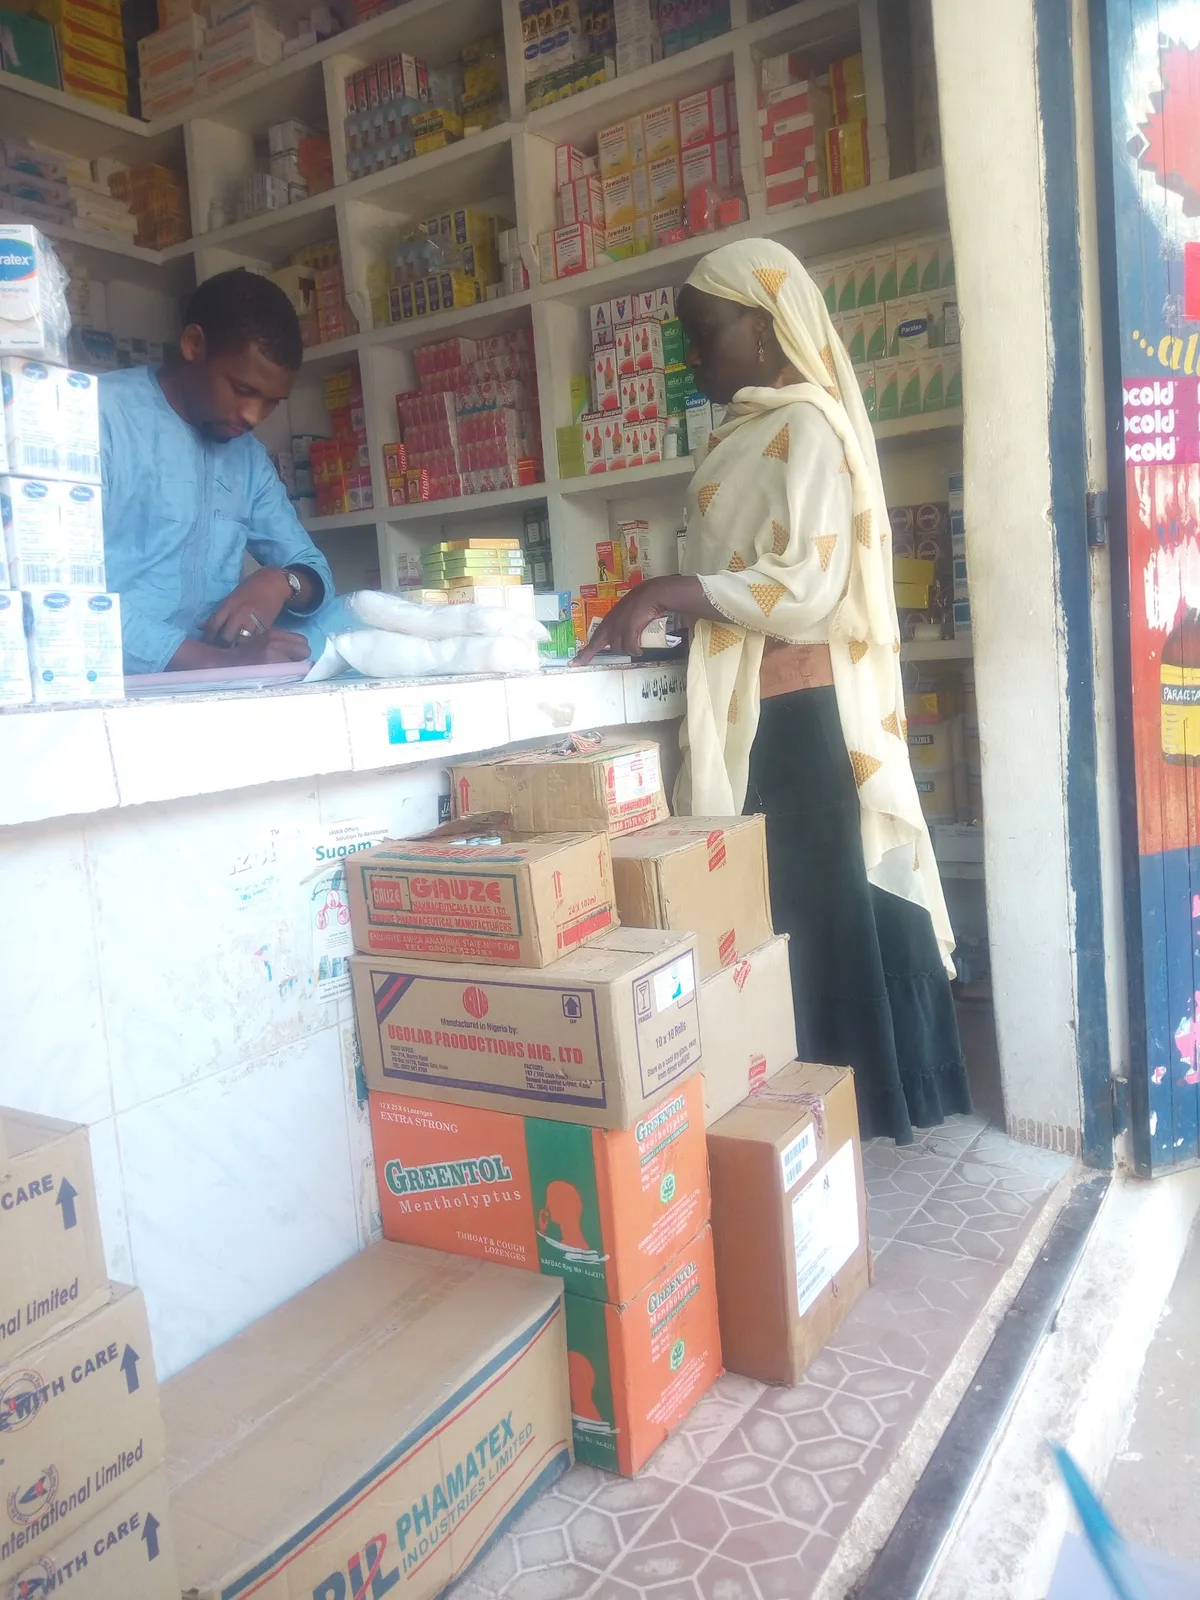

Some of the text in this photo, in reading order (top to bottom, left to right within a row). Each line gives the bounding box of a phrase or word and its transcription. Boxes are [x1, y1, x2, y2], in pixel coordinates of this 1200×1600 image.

[0, 254, 31, 266] ratex
[421, 469, 429, 500] Tutolin
[410, 877, 502, 903] GAUZE
[388, 1024, 583, 1065] UGOLAB PRODUCTIONS NIG. LTD
[487, 1023, 508, 1033] Nigeria
[380, 1111, 459, 1134] EXTRA STRONG
[635, 1094, 686, 1144] GREENTOL
[1, 1173, 54, 1211] CARE
[384, 1154, 513, 1197] GREENTOL
[399, 1188, 522, 1214] Mentholyptus
[456, 1231, 525, 1253] THROAT & COUGH
[484, 1246, 526, 1262] LOZENGES
[540, 1258, 562, 1269] NAFDAC
[562, 1263, 573, 1273] Reg
[0, 1278, 79, 1341] nal Limited
[71, 1342, 119, 1385] CARE
[0, 1438, 143, 1561] nternational Limited
[395, 1411, 515, 1551] PHAMATEX
[402, 1422, 533, 1573] INDUSTRIES LIMITED
[93, 1511, 140, 1556] CARE
